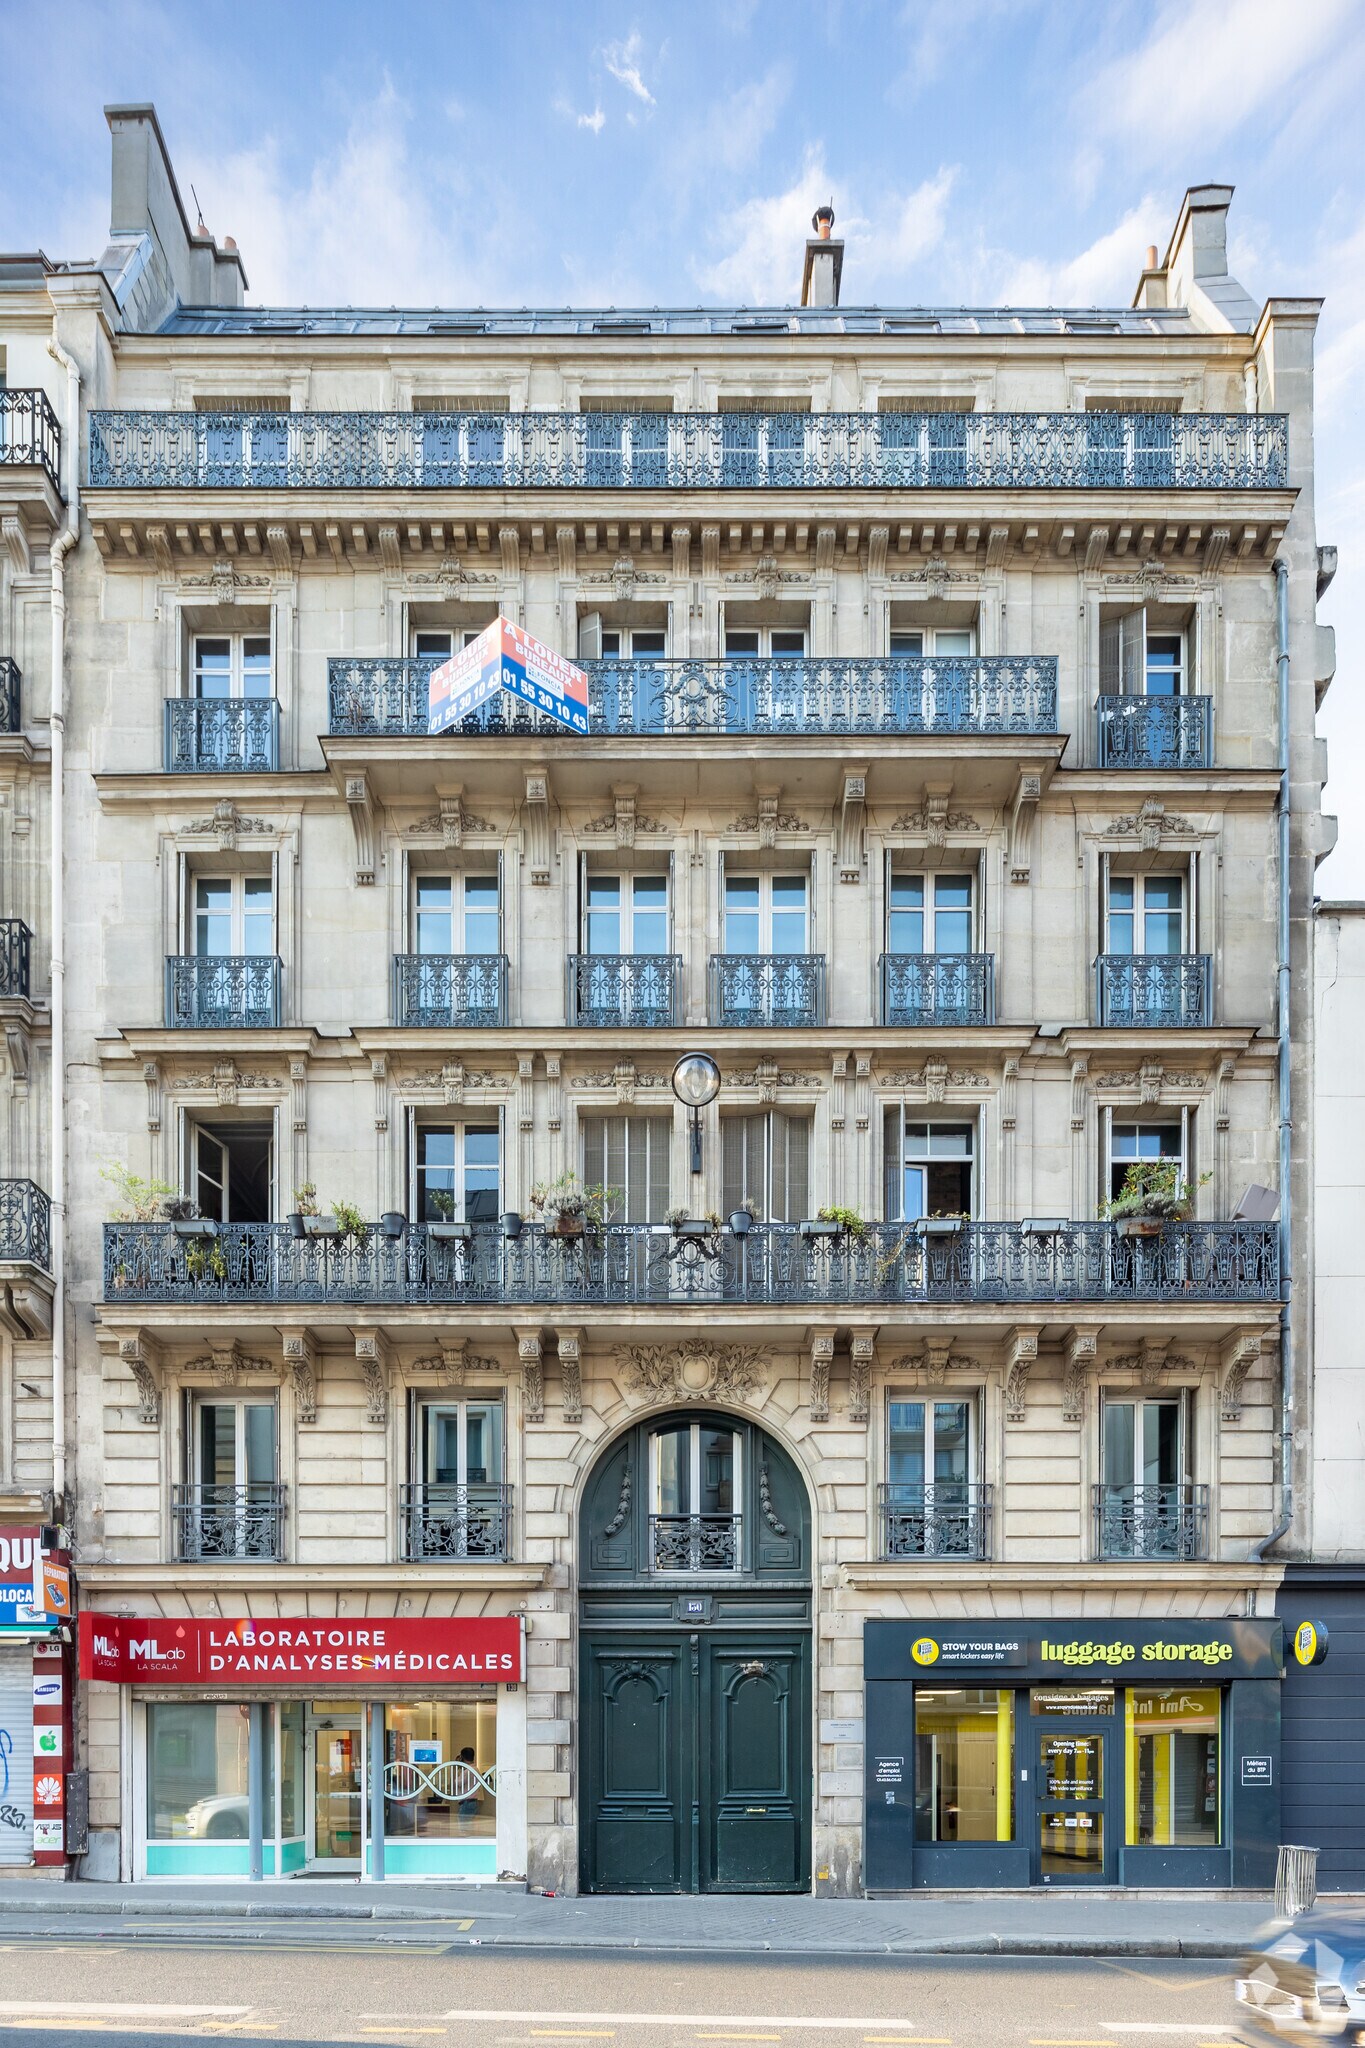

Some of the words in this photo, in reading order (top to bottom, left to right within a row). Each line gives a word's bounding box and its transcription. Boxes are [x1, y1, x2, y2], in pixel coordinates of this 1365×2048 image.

[433, 670, 444, 685] A
[449, 627, 497, 673] LOUER
[504, 623, 518, 640] A
[523, 634, 582, 683] LOUER
[442, 645, 488, 688] BUREAUX
[515, 642, 573, 688] BUREAUX
[532, 670, 562, 692] FONCIA
[431, 713, 442, 730] 01
[445, 703, 457, 721] 55
[459, 693, 471, 711] 30
[474, 682, 486, 699] 10
[488, 670, 500, 689] 43
[502, 668, 516, 688] 01
[520, 679, 535, 699] 55
[538, 690, 553, 710] 30
[556, 702, 570, 720] 10
[572, 713, 586, 730] 43
[0, 1588, 35, 1603] LOCA
[210, 1631, 386, 1647] LABORATOIRE
[942, 1643, 967, 1651] STOW
[969, 1643, 993, 1651] YOUR
[995, 1643, 1019, 1651] BAGS
[129, 1639, 186, 1660] MLab
[960, 1652, 980, 1660] lockers
[981, 1653, 994, 1661] easy
[995, 1652, 1004, 1661] life
[1041, 1640, 1135, 1665] luggage
[1141, 1640, 1233, 1665] storage
[137, 1663, 148, 1671] LA
[150, 1663, 178, 1671] SCALA
[210, 1654, 363, 1670] D'ANALYSES
[375, 1650, 513, 1670] MÉDICALES
[37, 1686, 58, 1694] SAMSUNG
[1033, 1693, 1068, 1702] consigne
[1077, 1693, 1109, 1702] bagages
[35, 1836, 62, 1844] acer
